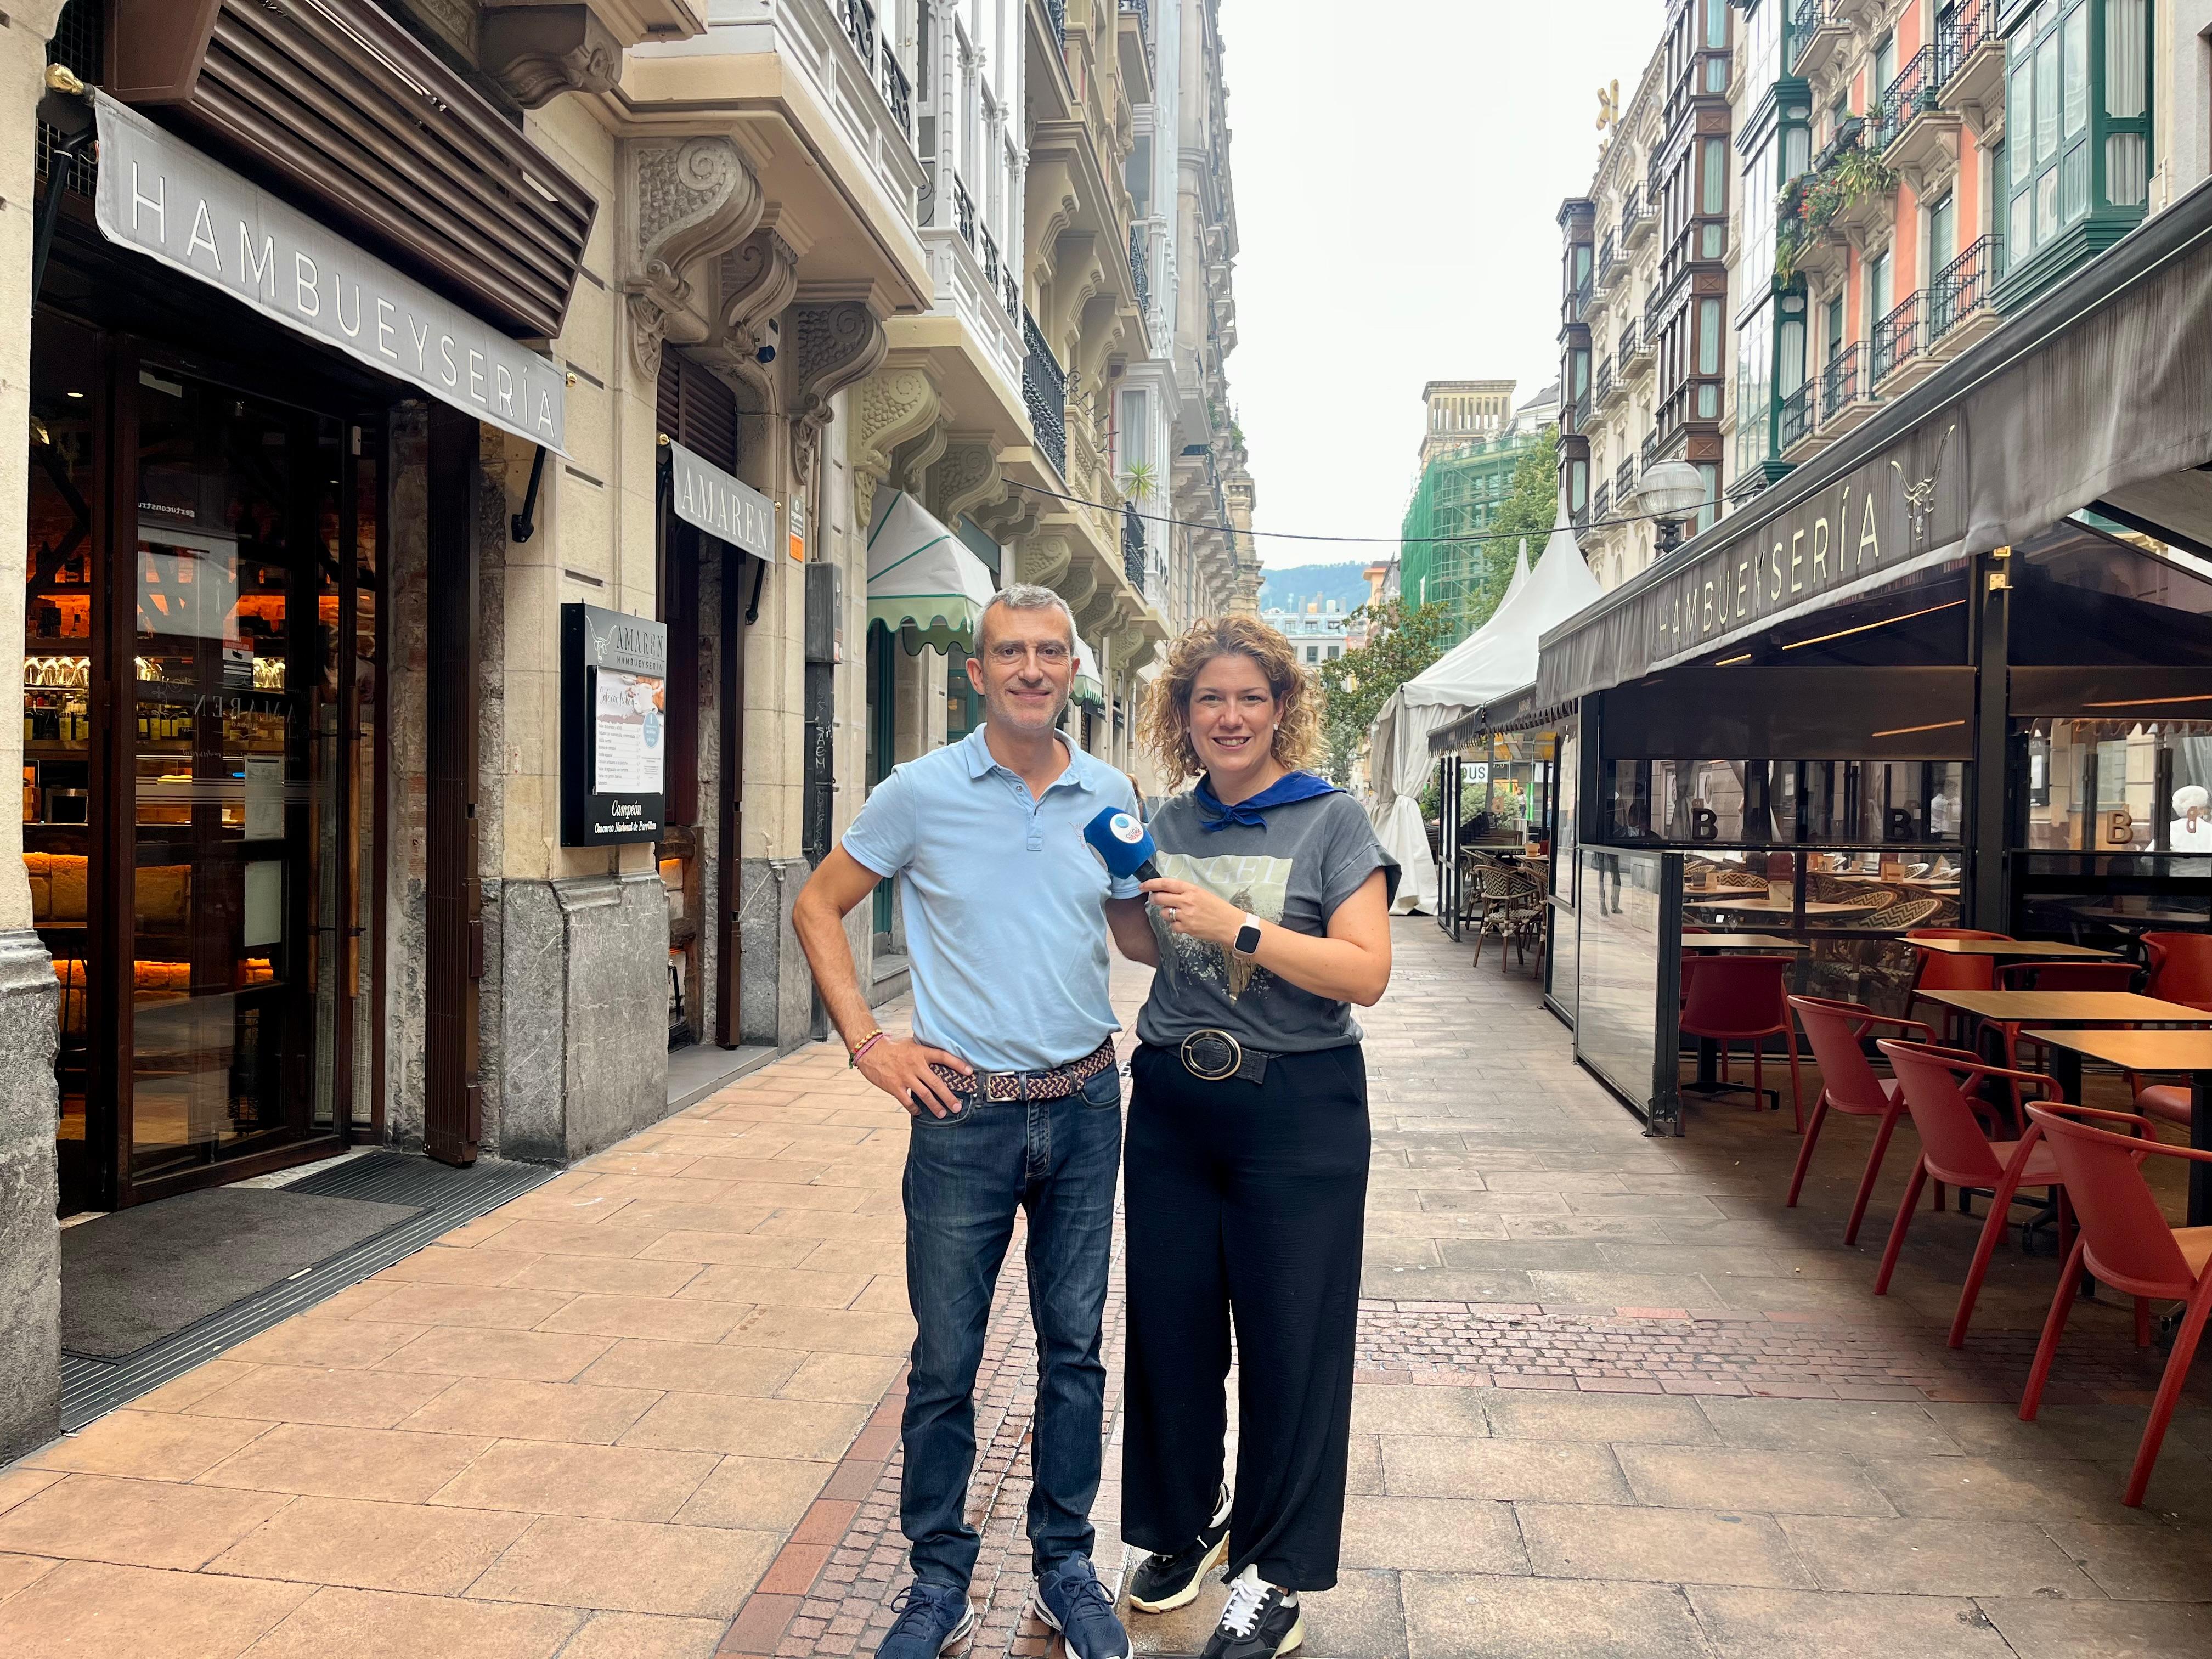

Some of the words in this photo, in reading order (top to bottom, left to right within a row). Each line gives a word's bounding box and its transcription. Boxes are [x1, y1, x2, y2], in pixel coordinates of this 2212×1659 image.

[133, 161, 554, 438] HAMBUEYSERÍA
[682, 467, 768, 551] AMAREN
[1659, 486, 1879, 650] HAMBUEYSERÍA
[617, 626, 663, 658] AMAREN
[612, 800, 642, 819] Campeón
[1692, 808, 1718, 840] B
[595, 823, 614, 833] Concurso
[614, 821, 633, 832] Nacional
[633, 822, 638, 831] de
[2106, 810, 2133, 844] B
